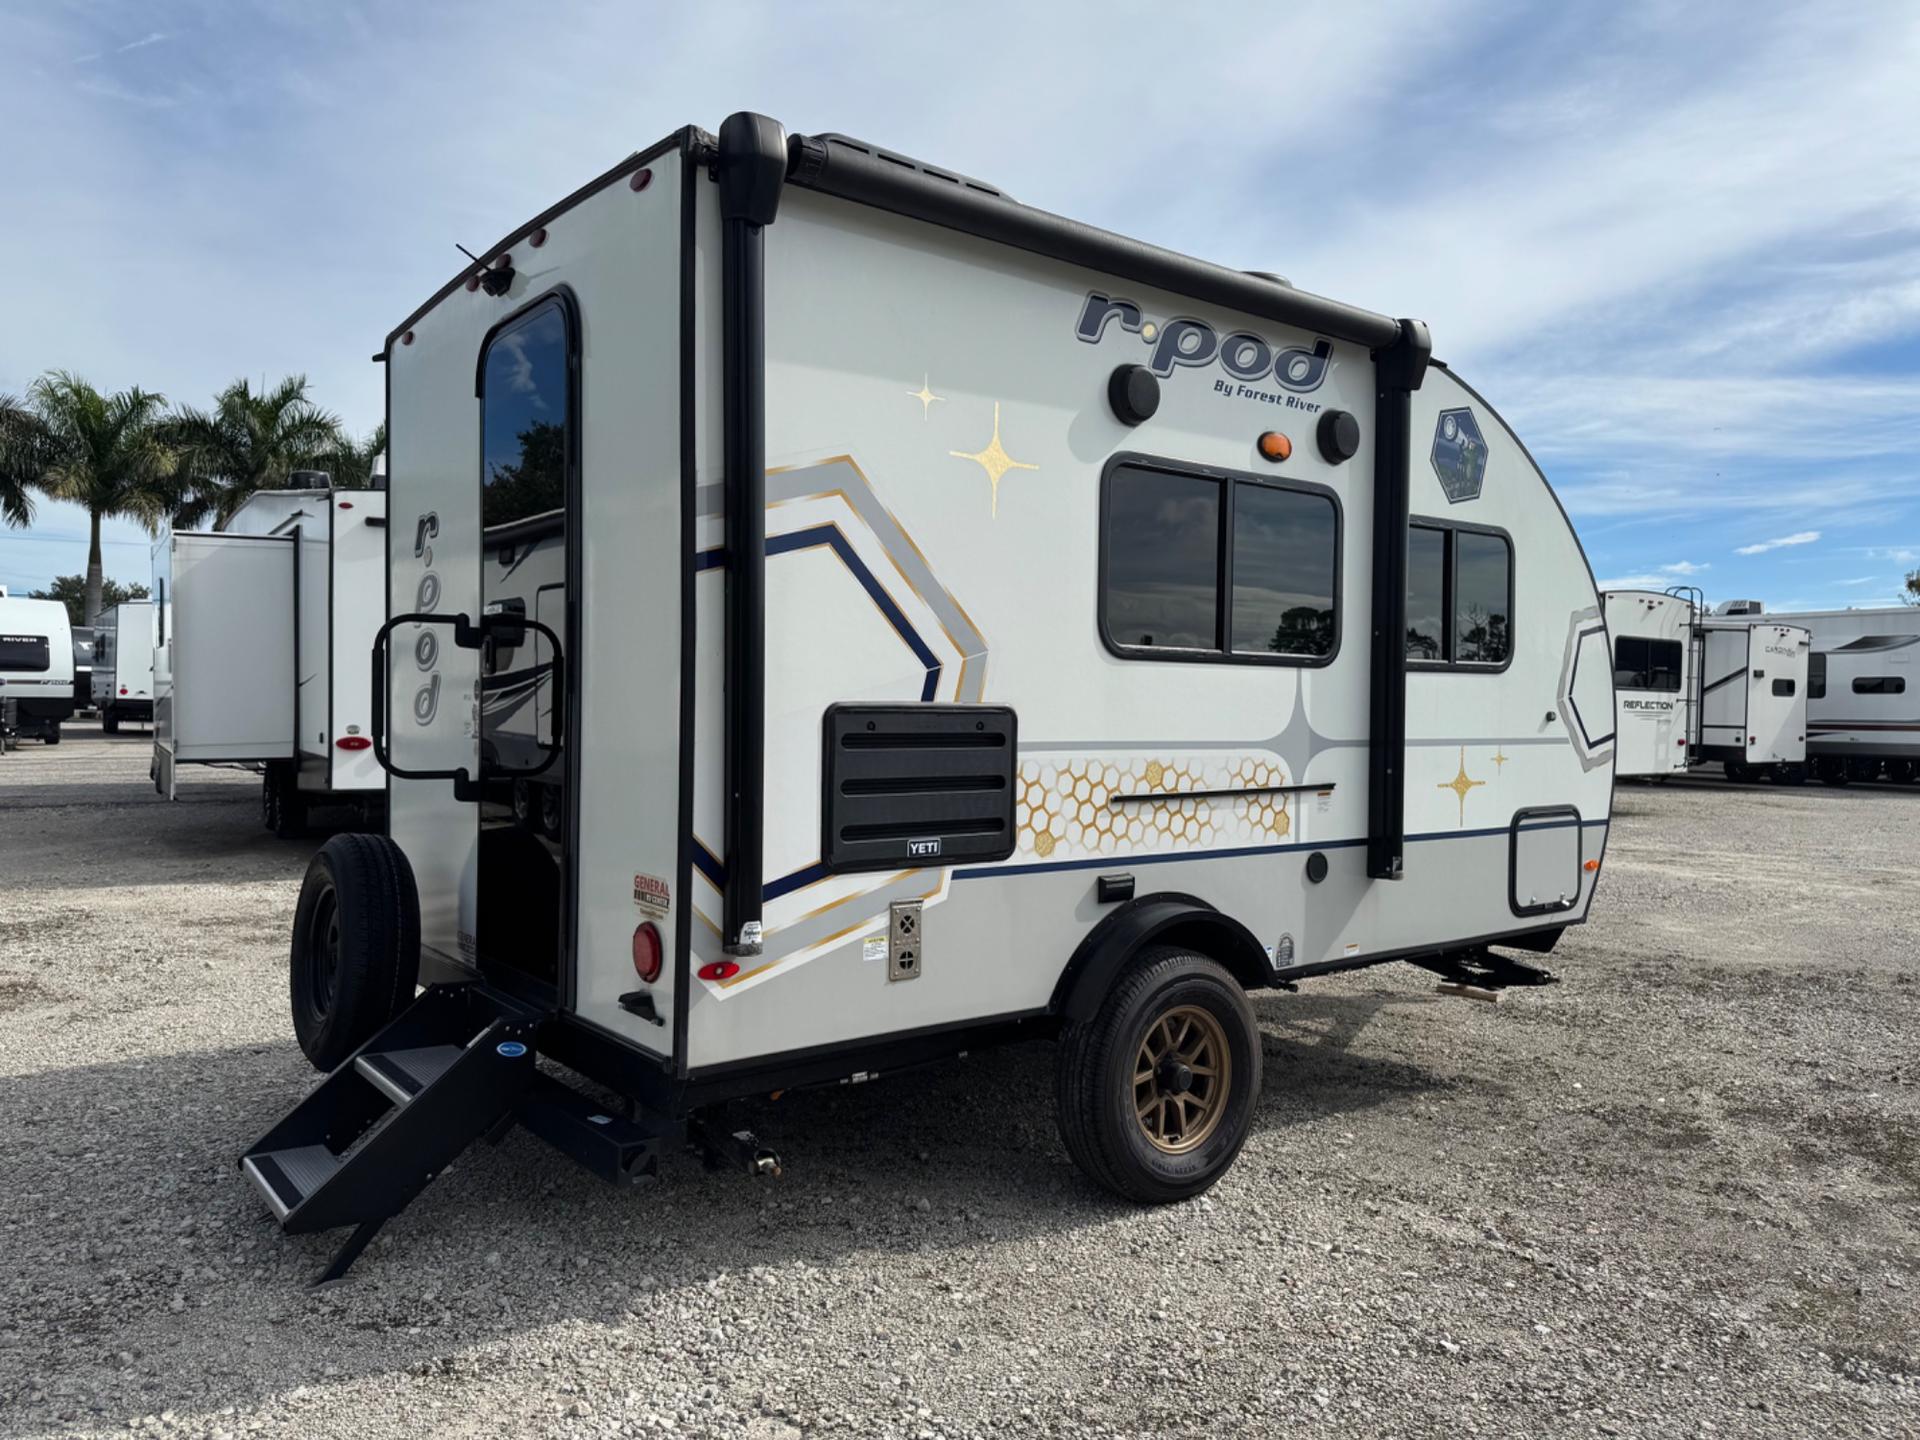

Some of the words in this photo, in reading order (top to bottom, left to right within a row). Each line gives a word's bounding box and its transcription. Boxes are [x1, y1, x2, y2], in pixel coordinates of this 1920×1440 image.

[1214, 379, 1234, 397] By
[1236, 384, 1283, 406] Forest
[1286, 396, 1322, 414] River
[1623, 700, 1673, 710] REFLECTION
[910, 841, 938, 854] YETI
[634, 874, 670, 897] GENERAL
